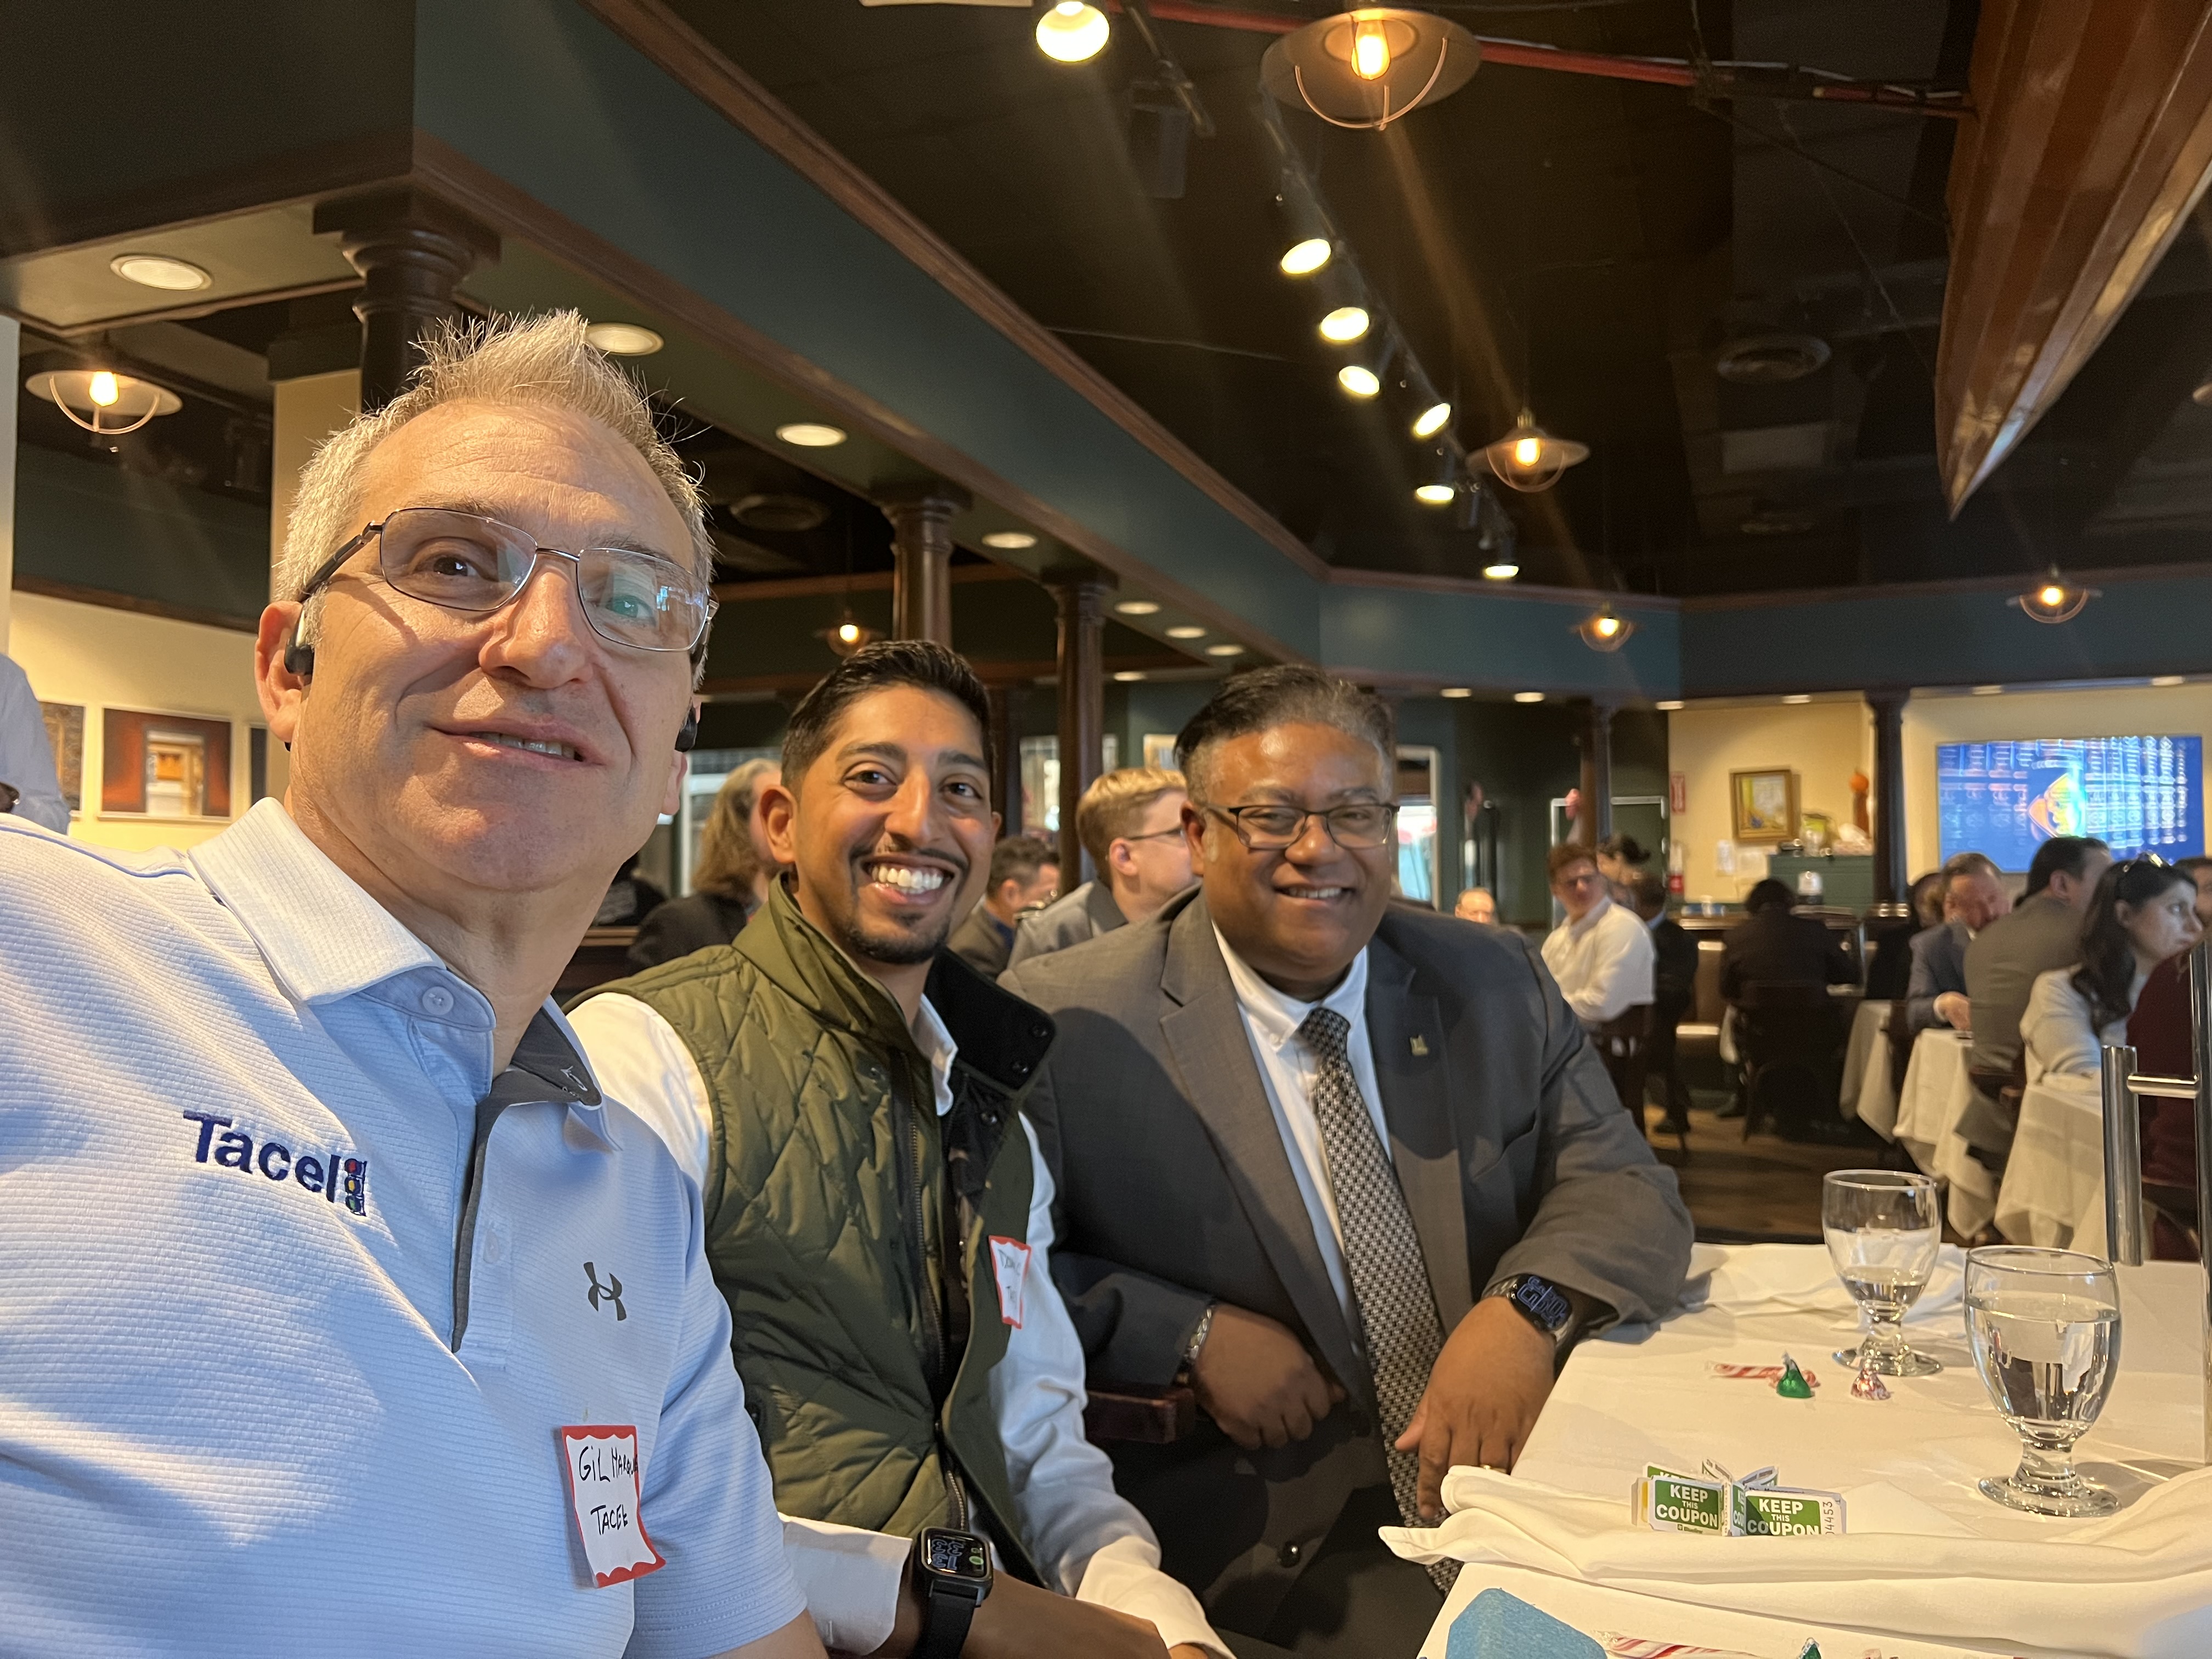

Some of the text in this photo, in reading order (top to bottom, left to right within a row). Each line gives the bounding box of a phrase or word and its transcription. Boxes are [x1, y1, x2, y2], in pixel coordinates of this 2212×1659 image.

[183, 1109, 341, 1204] Tacel
[1670, 1484, 1708, 1503] KEEP
[1682, 1500, 1699, 1509] THIS
[1759, 1498, 1803, 1514] KEEP
[1656, 1504, 1718, 1527] COUPON
[1771, 1514, 1790, 1522] THIS
[1747, 1519, 1819, 1536] COUPON
